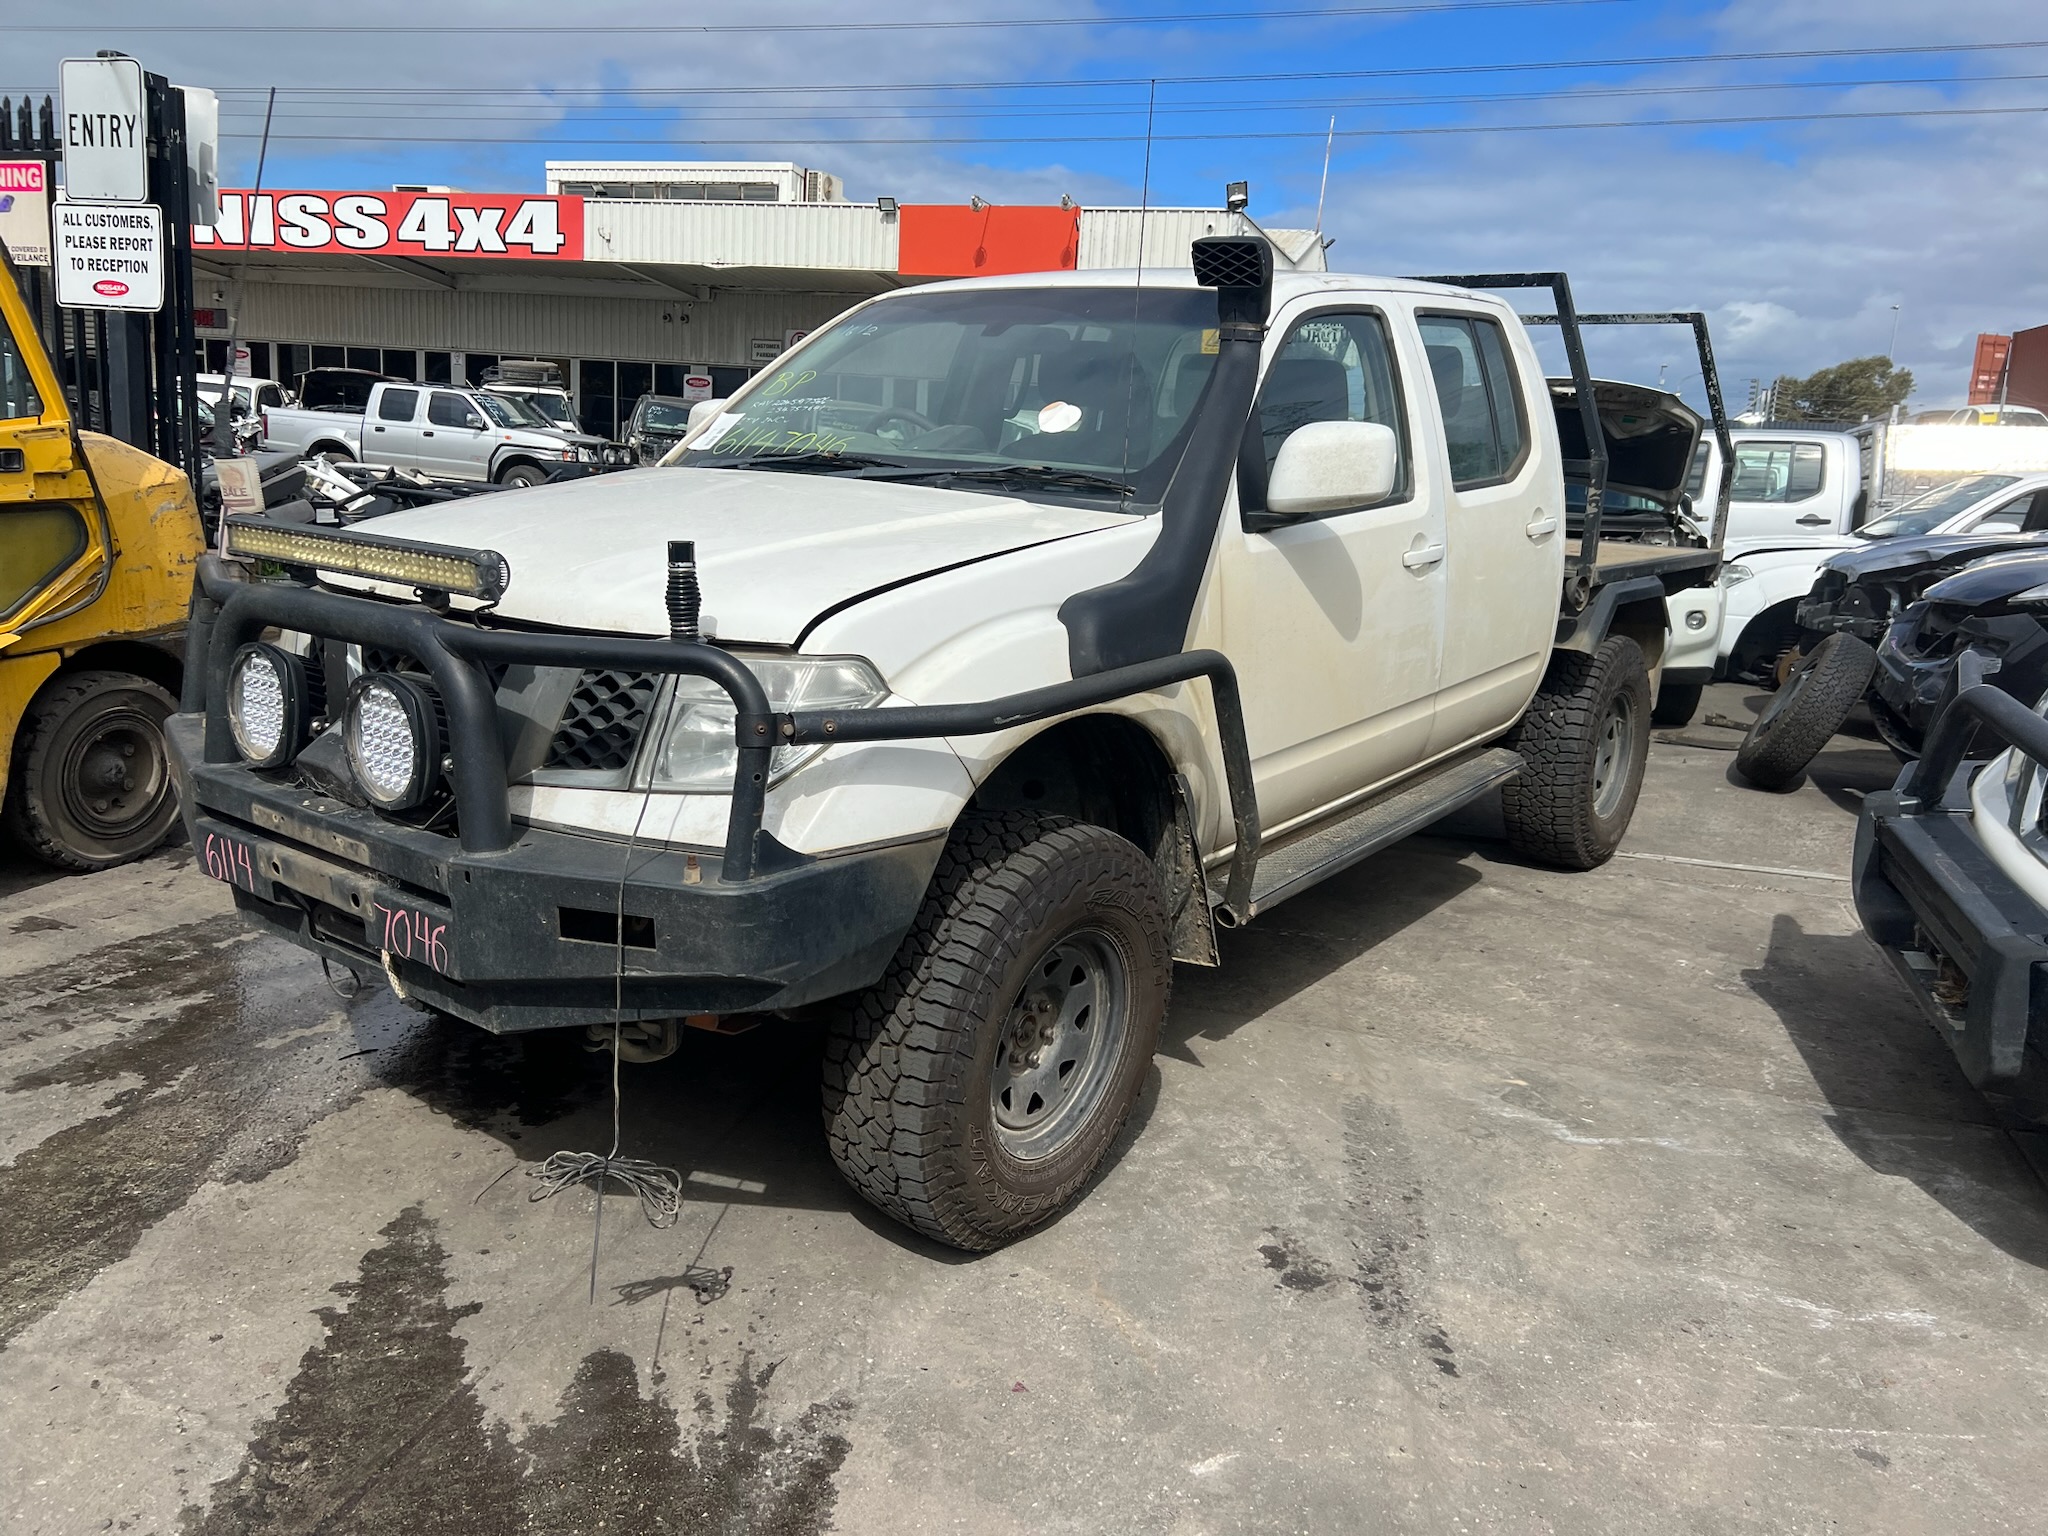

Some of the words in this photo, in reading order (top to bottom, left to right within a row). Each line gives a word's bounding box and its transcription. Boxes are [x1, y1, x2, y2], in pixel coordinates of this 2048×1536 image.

[69, 113, 136, 148] ENTRY
[63, 213, 82, 227] ALL
[85, 214, 154, 232] CUSTOMERS,
[193, 194, 389, 249] NISS
[397, 197, 565, 254] 4x4
[65, 235, 107, 250] PLEASE
[110, 237, 153, 251] REPORT
[71, 257, 84, 271] TO
[88, 258, 149, 274] RECEPTION
[762, 370, 816, 396] BP
[205, 833, 254, 893] 6114
[373, 902, 448, 975] 7046
